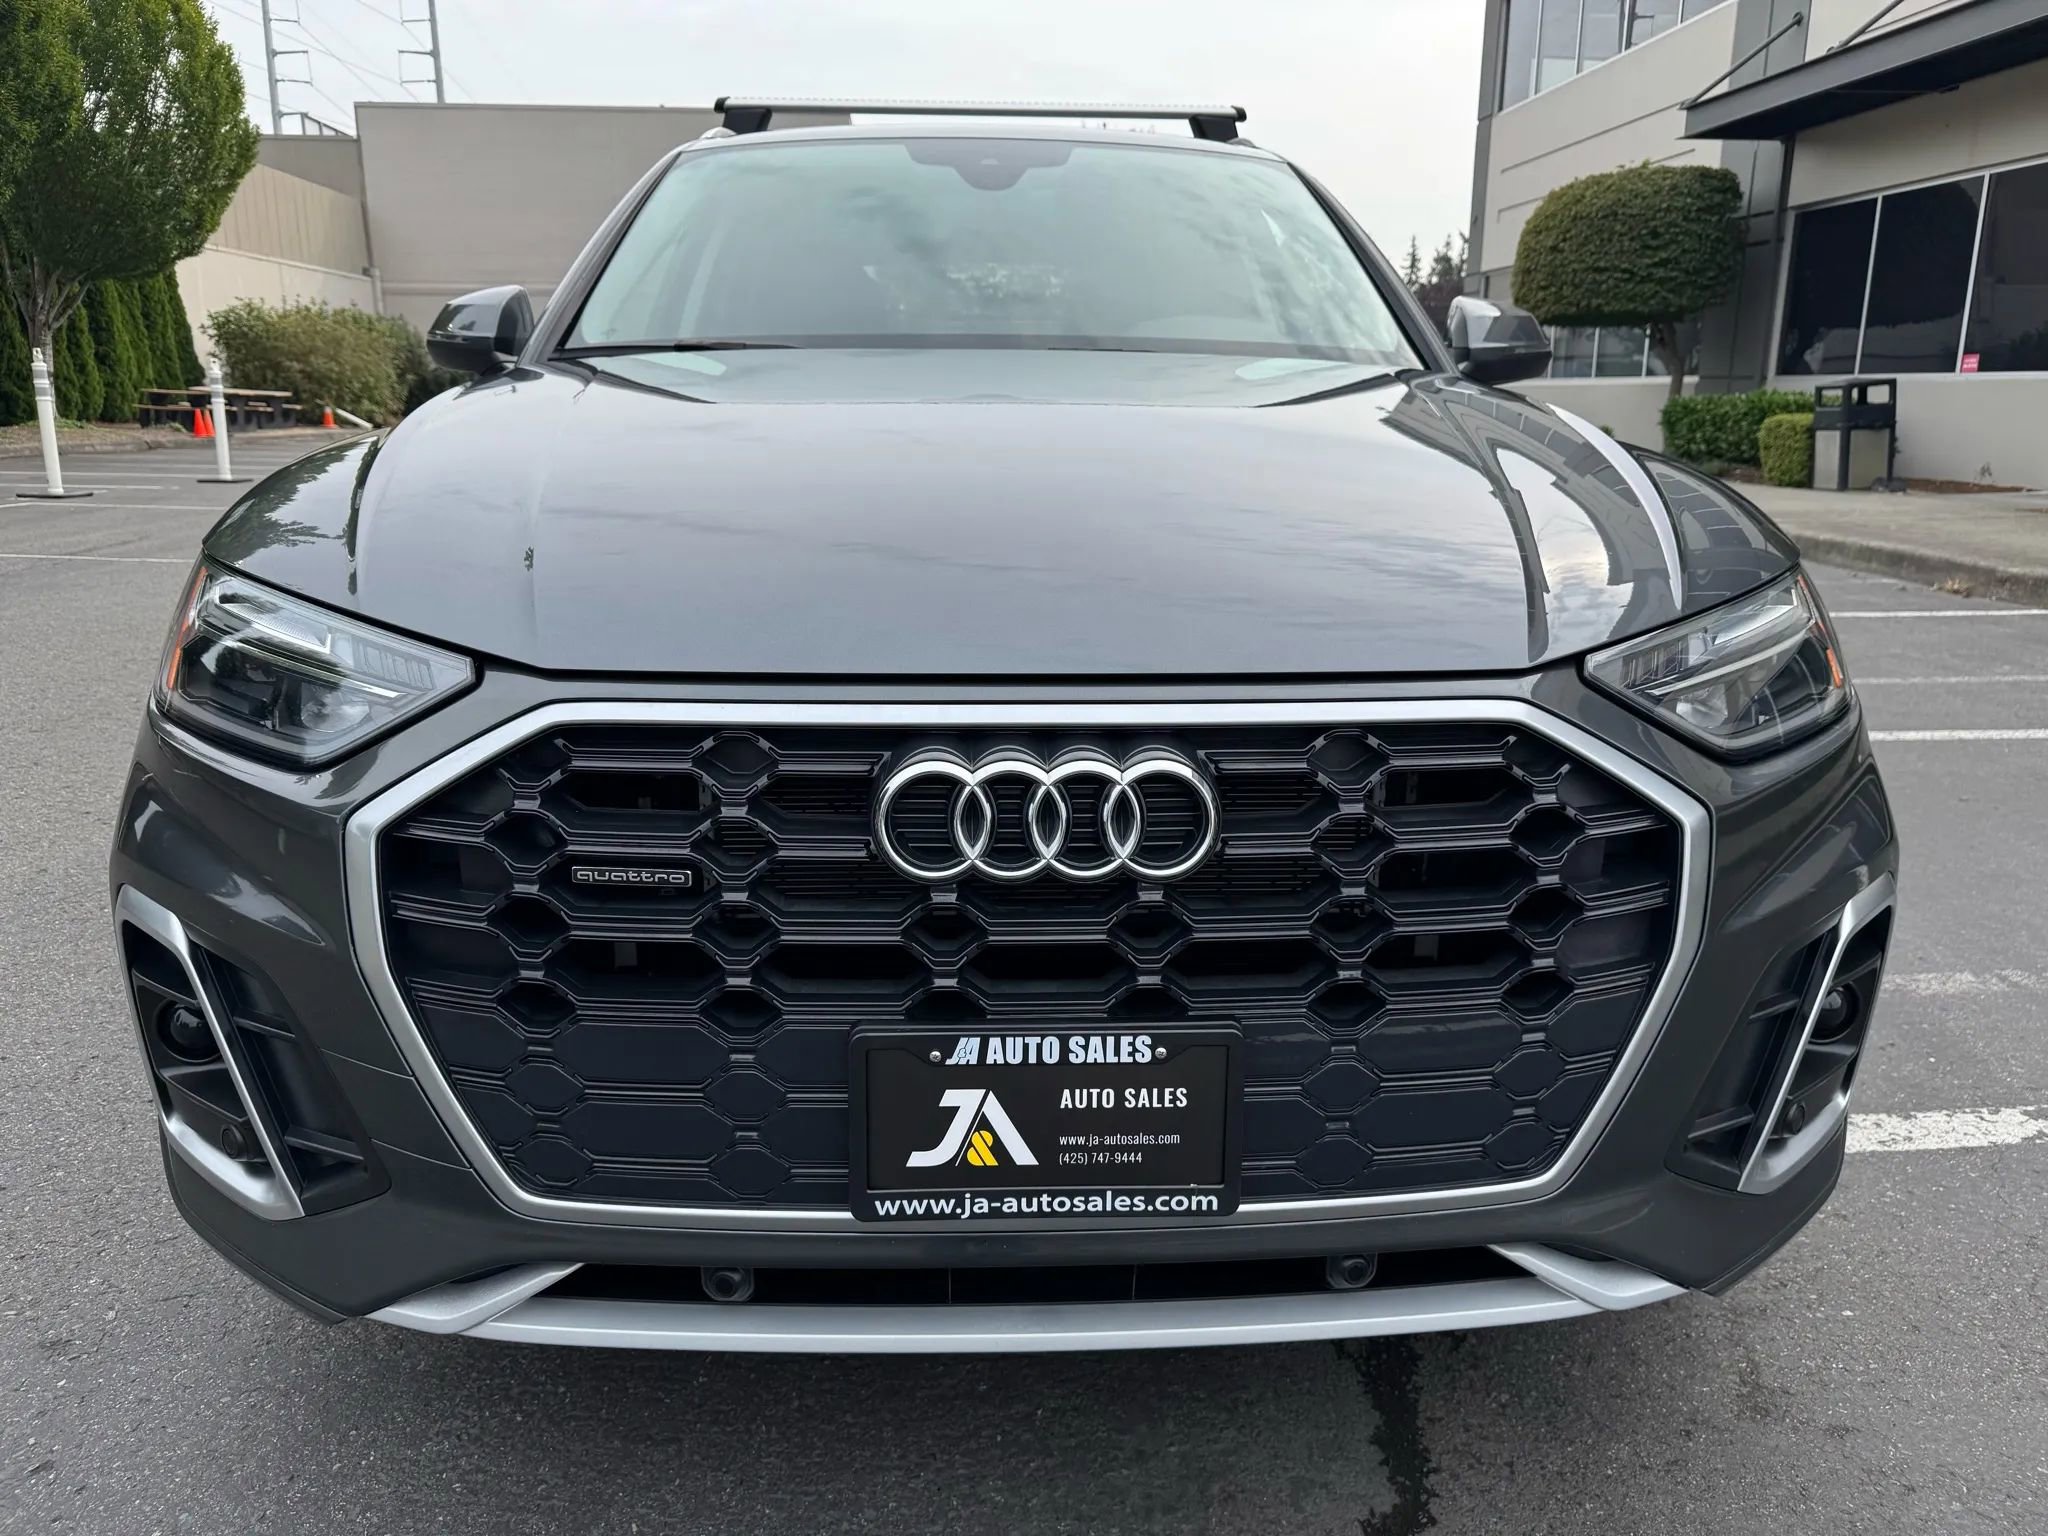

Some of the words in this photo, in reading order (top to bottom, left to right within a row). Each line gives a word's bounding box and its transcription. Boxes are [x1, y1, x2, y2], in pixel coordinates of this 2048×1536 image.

[576, 871, 685, 883] quattro
[986, 1036, 1060, 1065] AUTO
[1068, 1035, 1153, 1063] SALES
[1060, 1088, 1115, 1108] AUTO
[1124, 1087, 1188, 1108] SALES
[1059, 1132, 1180, 1147] www.ja-autosales.com
[1059, 1152, 1089, 1165] (425)
[1091, 1151, 1143, 1164] 747-9444
[874, 1190, 1219, 1219] www.ja-autosales.com
